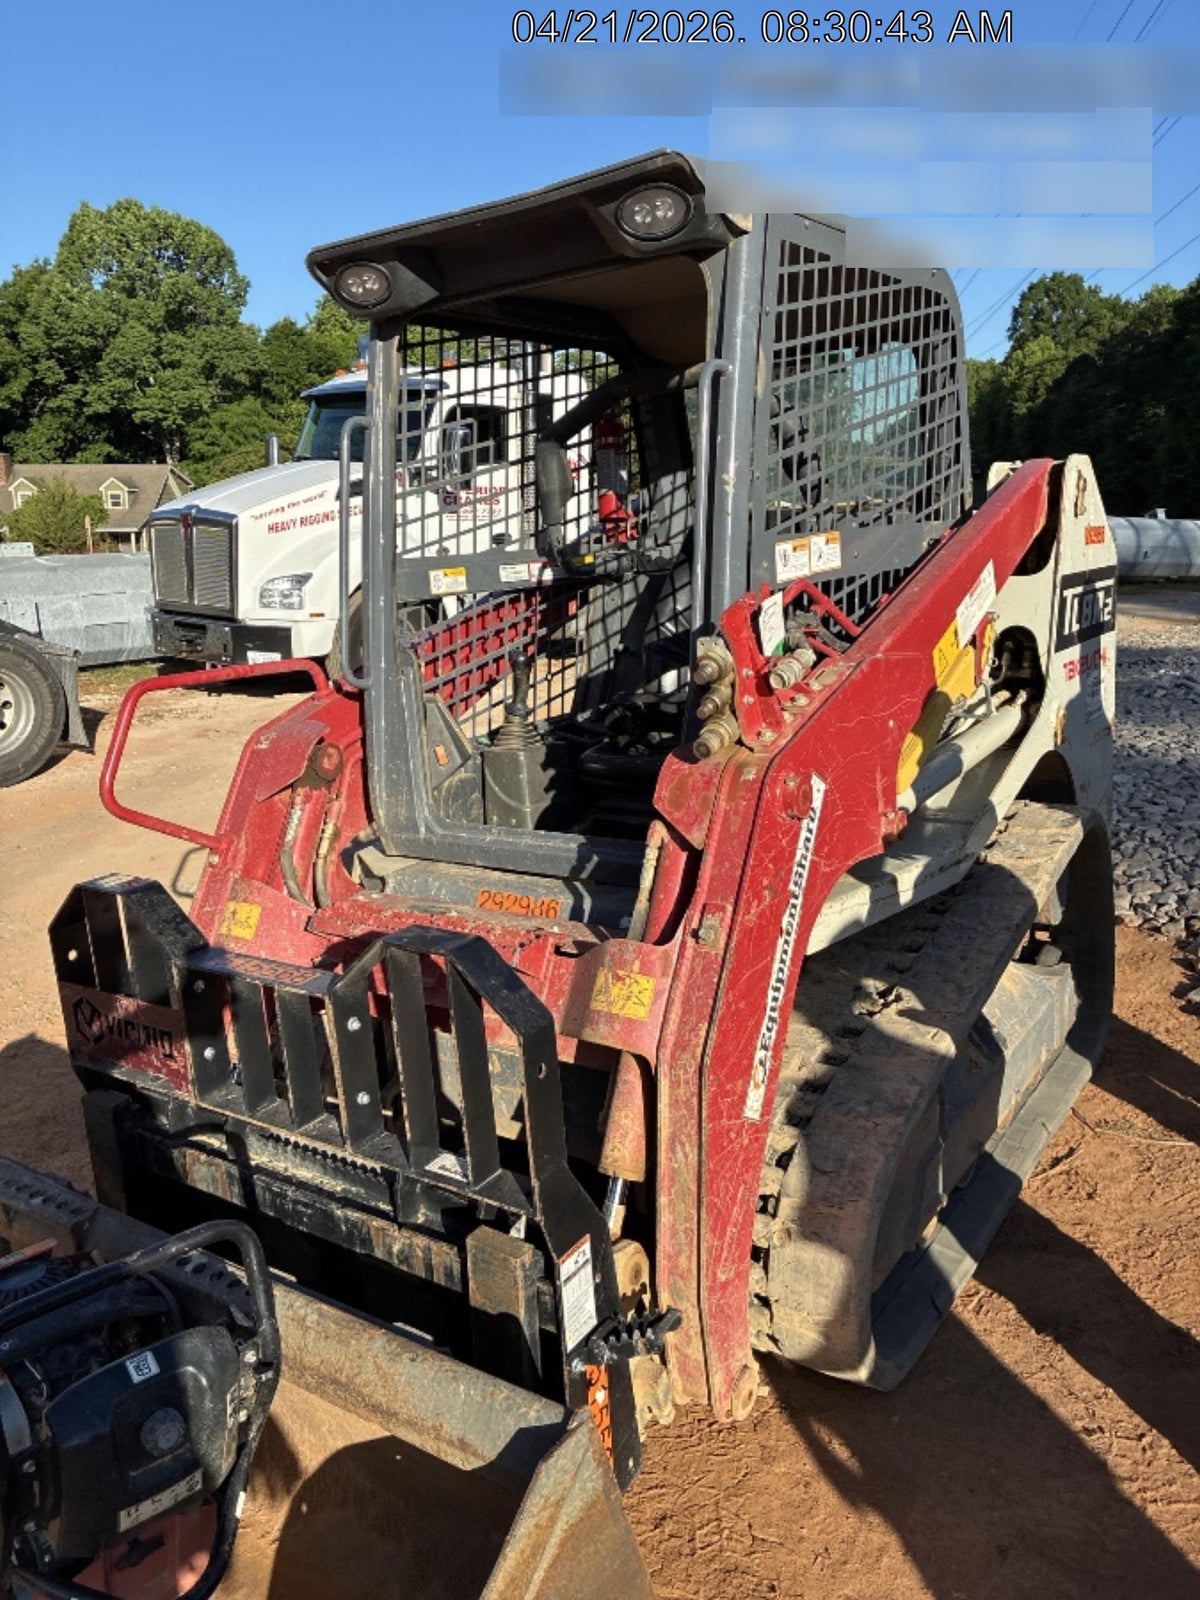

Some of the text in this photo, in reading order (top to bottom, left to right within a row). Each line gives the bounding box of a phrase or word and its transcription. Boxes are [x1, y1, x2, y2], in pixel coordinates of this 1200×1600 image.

[268, 517, 298, 534] HEAVY
[300, 509, 336, 529] RIGGING
[479, 889, 560, 919] 292986
[758, 805, 817, 1053] EquipmentShare
